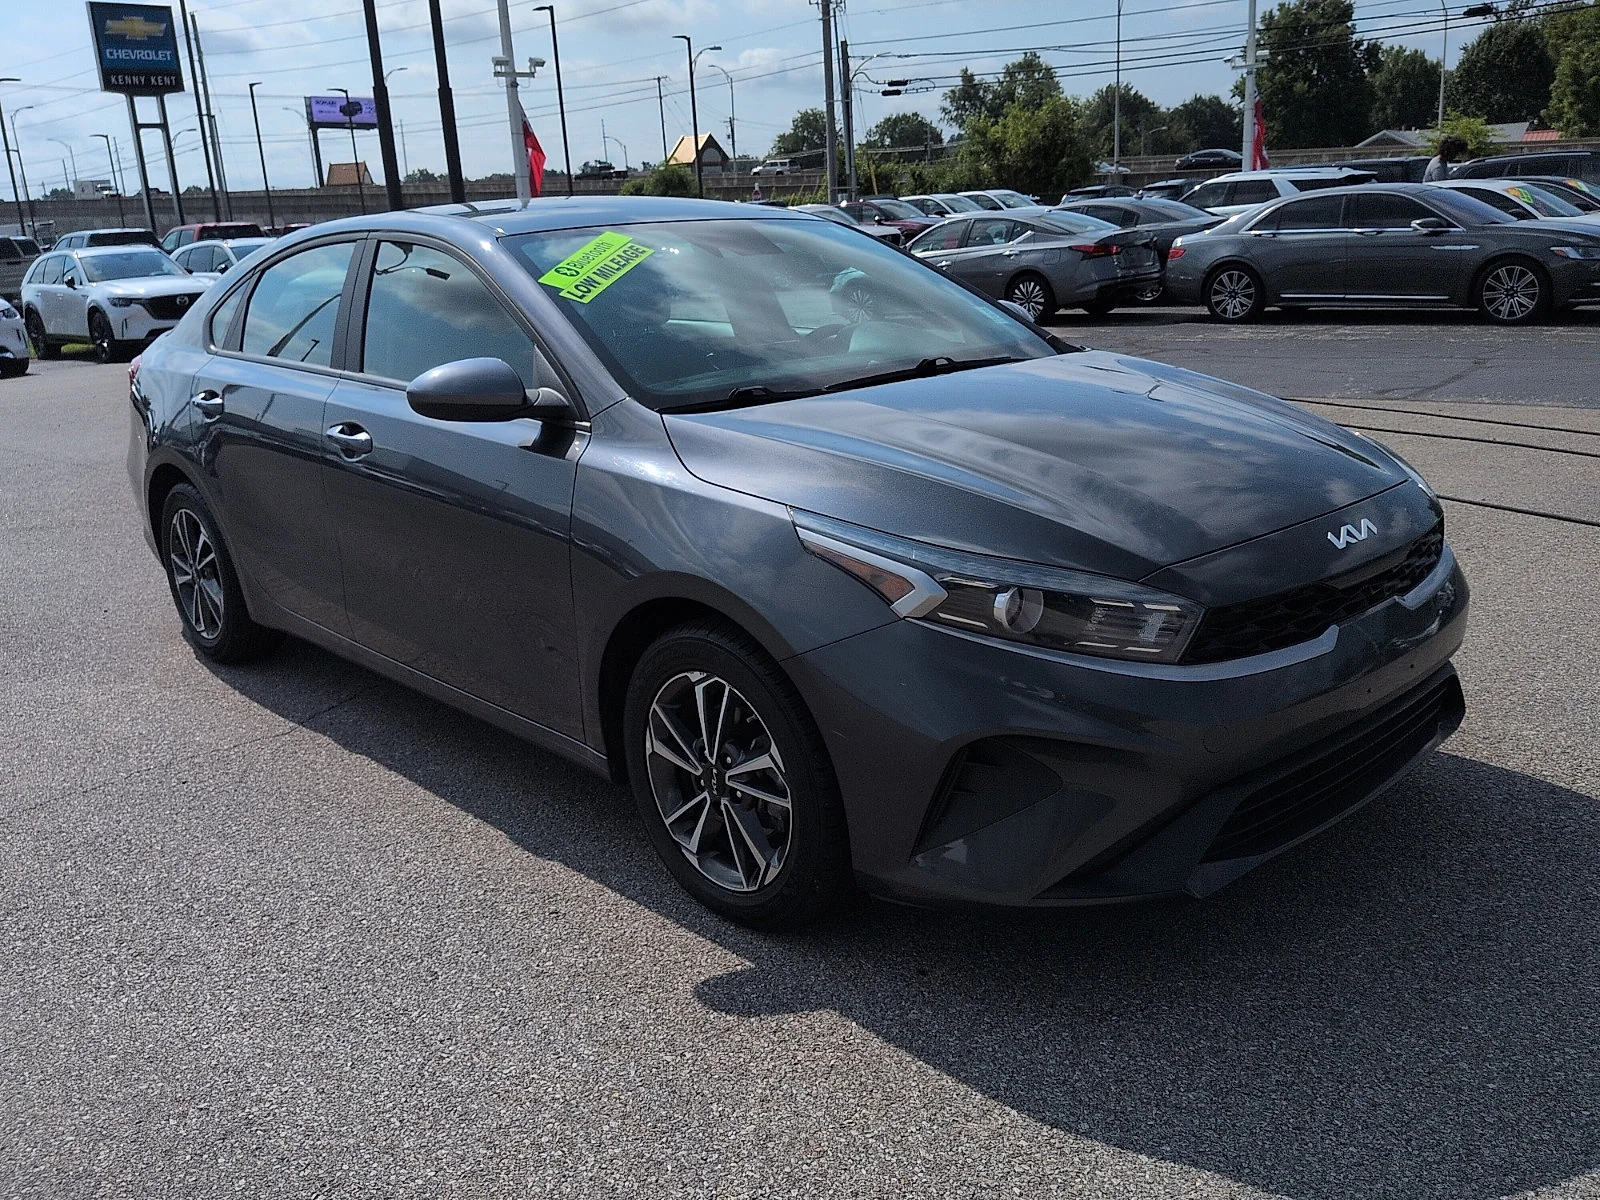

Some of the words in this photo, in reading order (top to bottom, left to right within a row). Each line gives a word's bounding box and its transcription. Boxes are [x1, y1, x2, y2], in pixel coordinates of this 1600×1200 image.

[106, 49, 172, 60] CHEVROLET
[111, 75, 146, 85] KENNY
[151, 76, 177, 86] KENT
[567, 241, 614, 270] Bluetooth
[567, 275, 602, 299] LOW
[593, 245, 647, 280] MILEAGE
[1327, 518, 1378, 550] KIA
